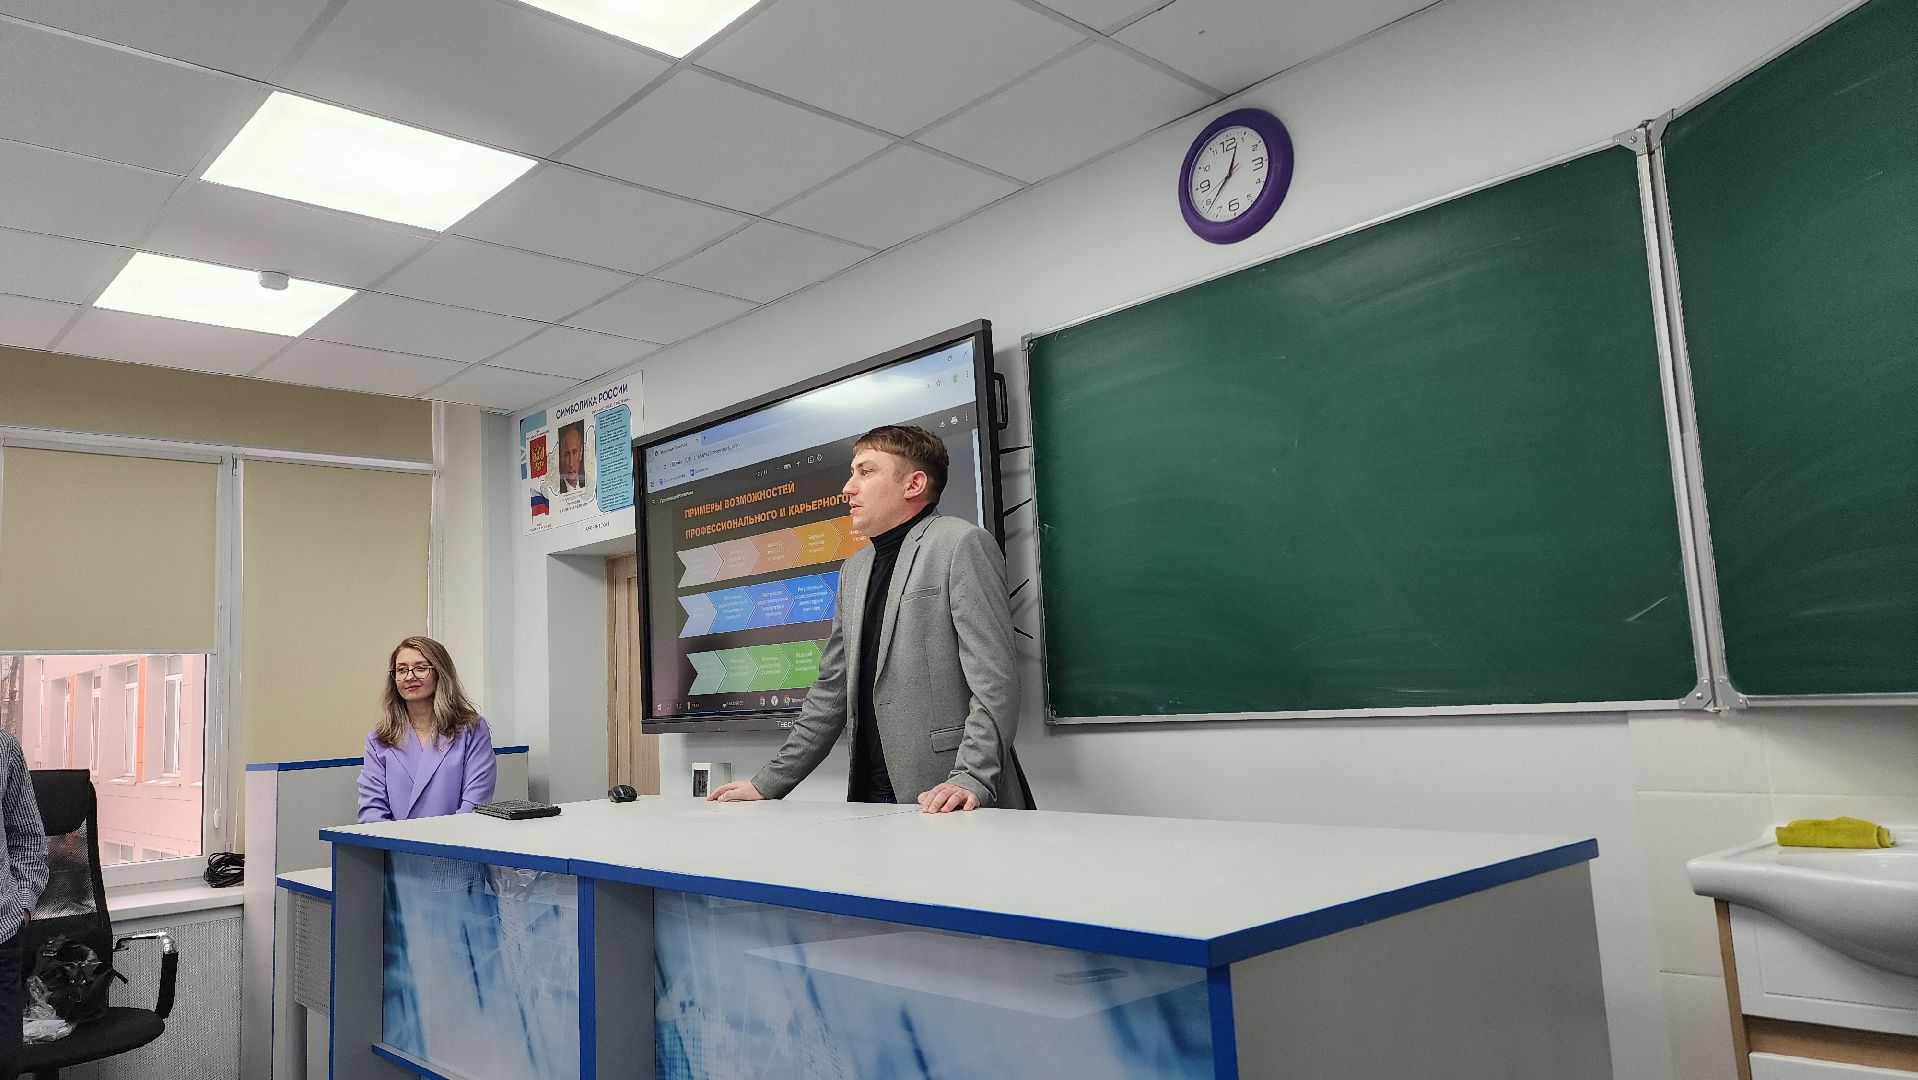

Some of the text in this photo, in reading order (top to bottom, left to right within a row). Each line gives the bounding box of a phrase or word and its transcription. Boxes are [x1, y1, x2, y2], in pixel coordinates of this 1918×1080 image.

[1220, 137, 1237, 154] 12
[1252, 143, 1259, 152] 2
[1203, 164, 1211, 173] 10
[1252, 156, 1264, 172] 3
[1199, 179, 1211, 194] 9
[1228, 198, 1240, 212] 6
[556, 396, 598, 420] СИМВОЛИКА
[598, 383, 629, 404] РОССИИ
[684, 481, 796, 519] ПРИМЕРЫ ВОЗМОЖНОСТЕЙ
[685, 493, 849, 540] ПРОФЕССИОНАЛЬНОГО И КАРЬЕРНОГО
